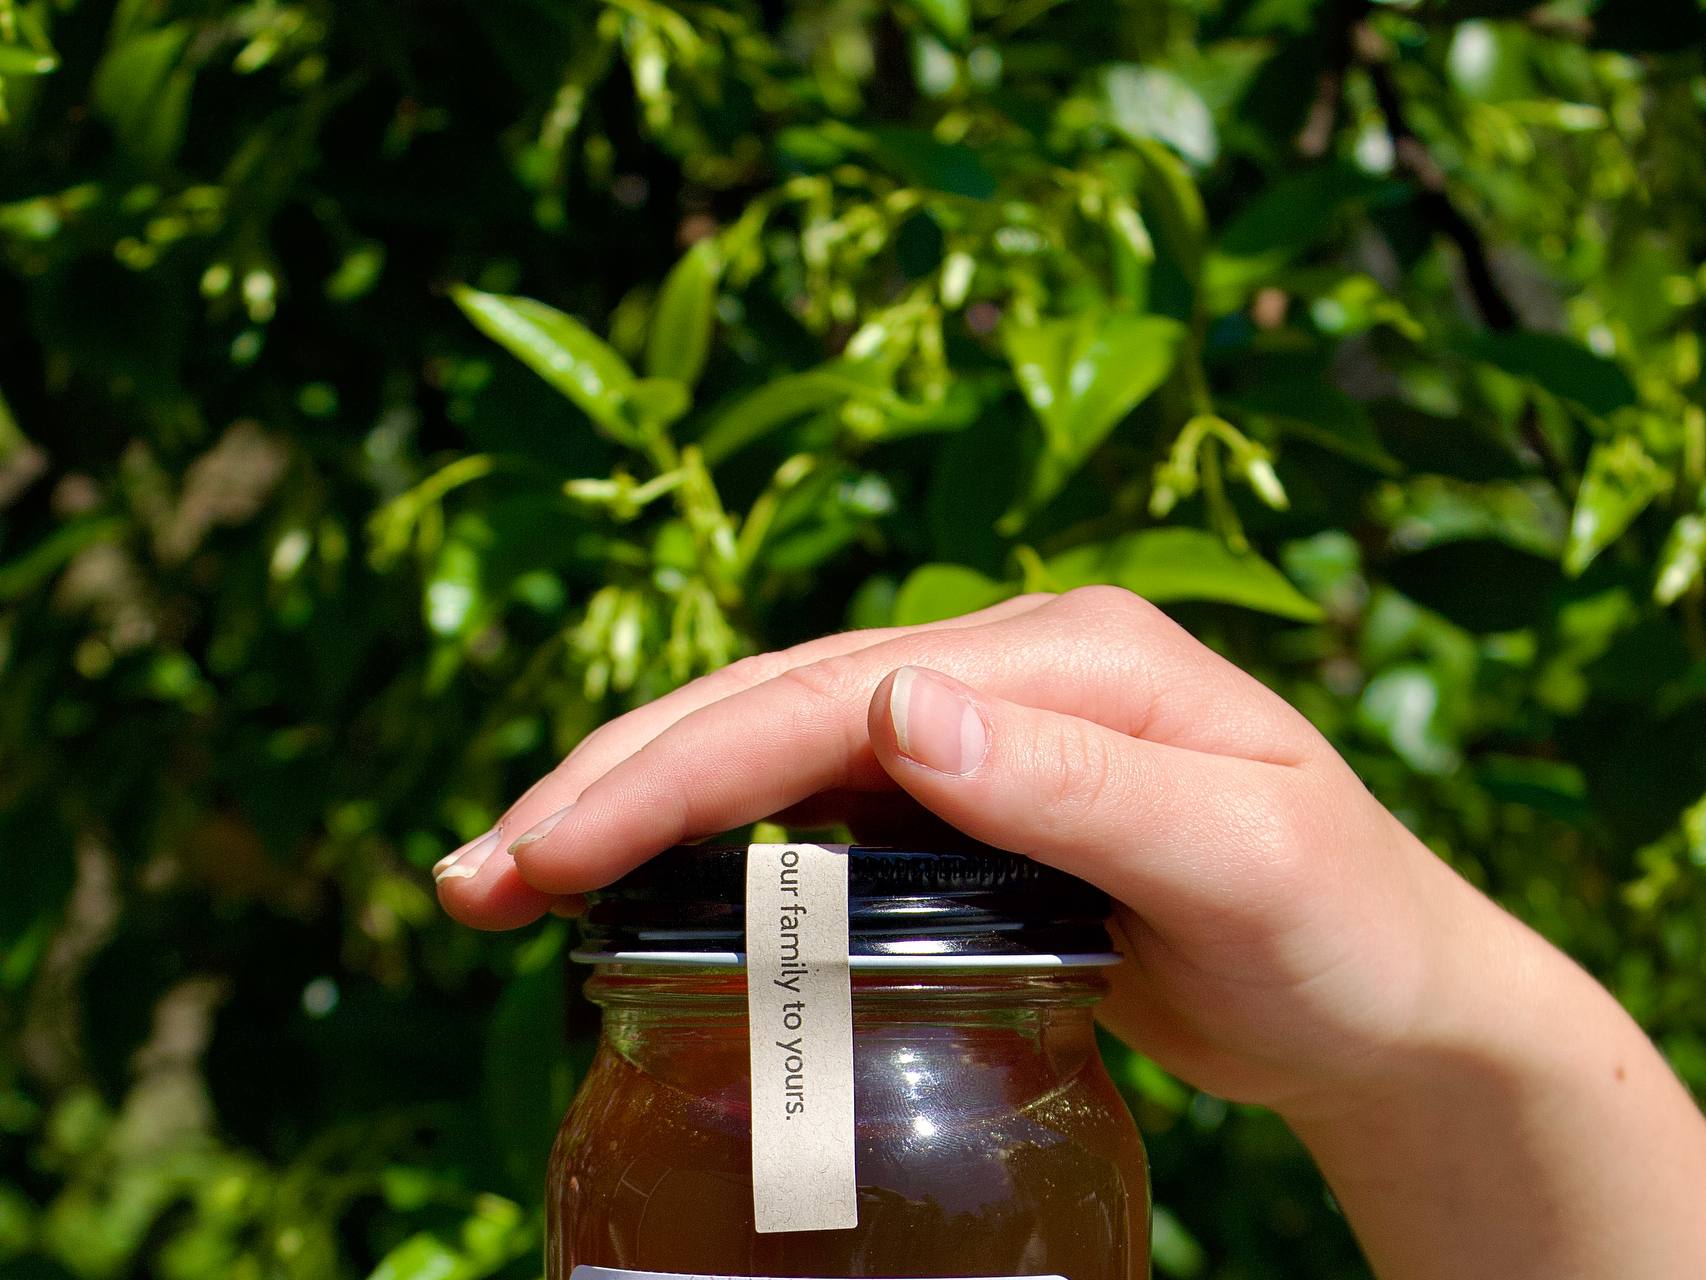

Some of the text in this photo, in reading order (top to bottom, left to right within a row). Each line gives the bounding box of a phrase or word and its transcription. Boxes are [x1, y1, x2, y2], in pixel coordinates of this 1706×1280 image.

[773, 850, 807, 1121] our family to yours.
